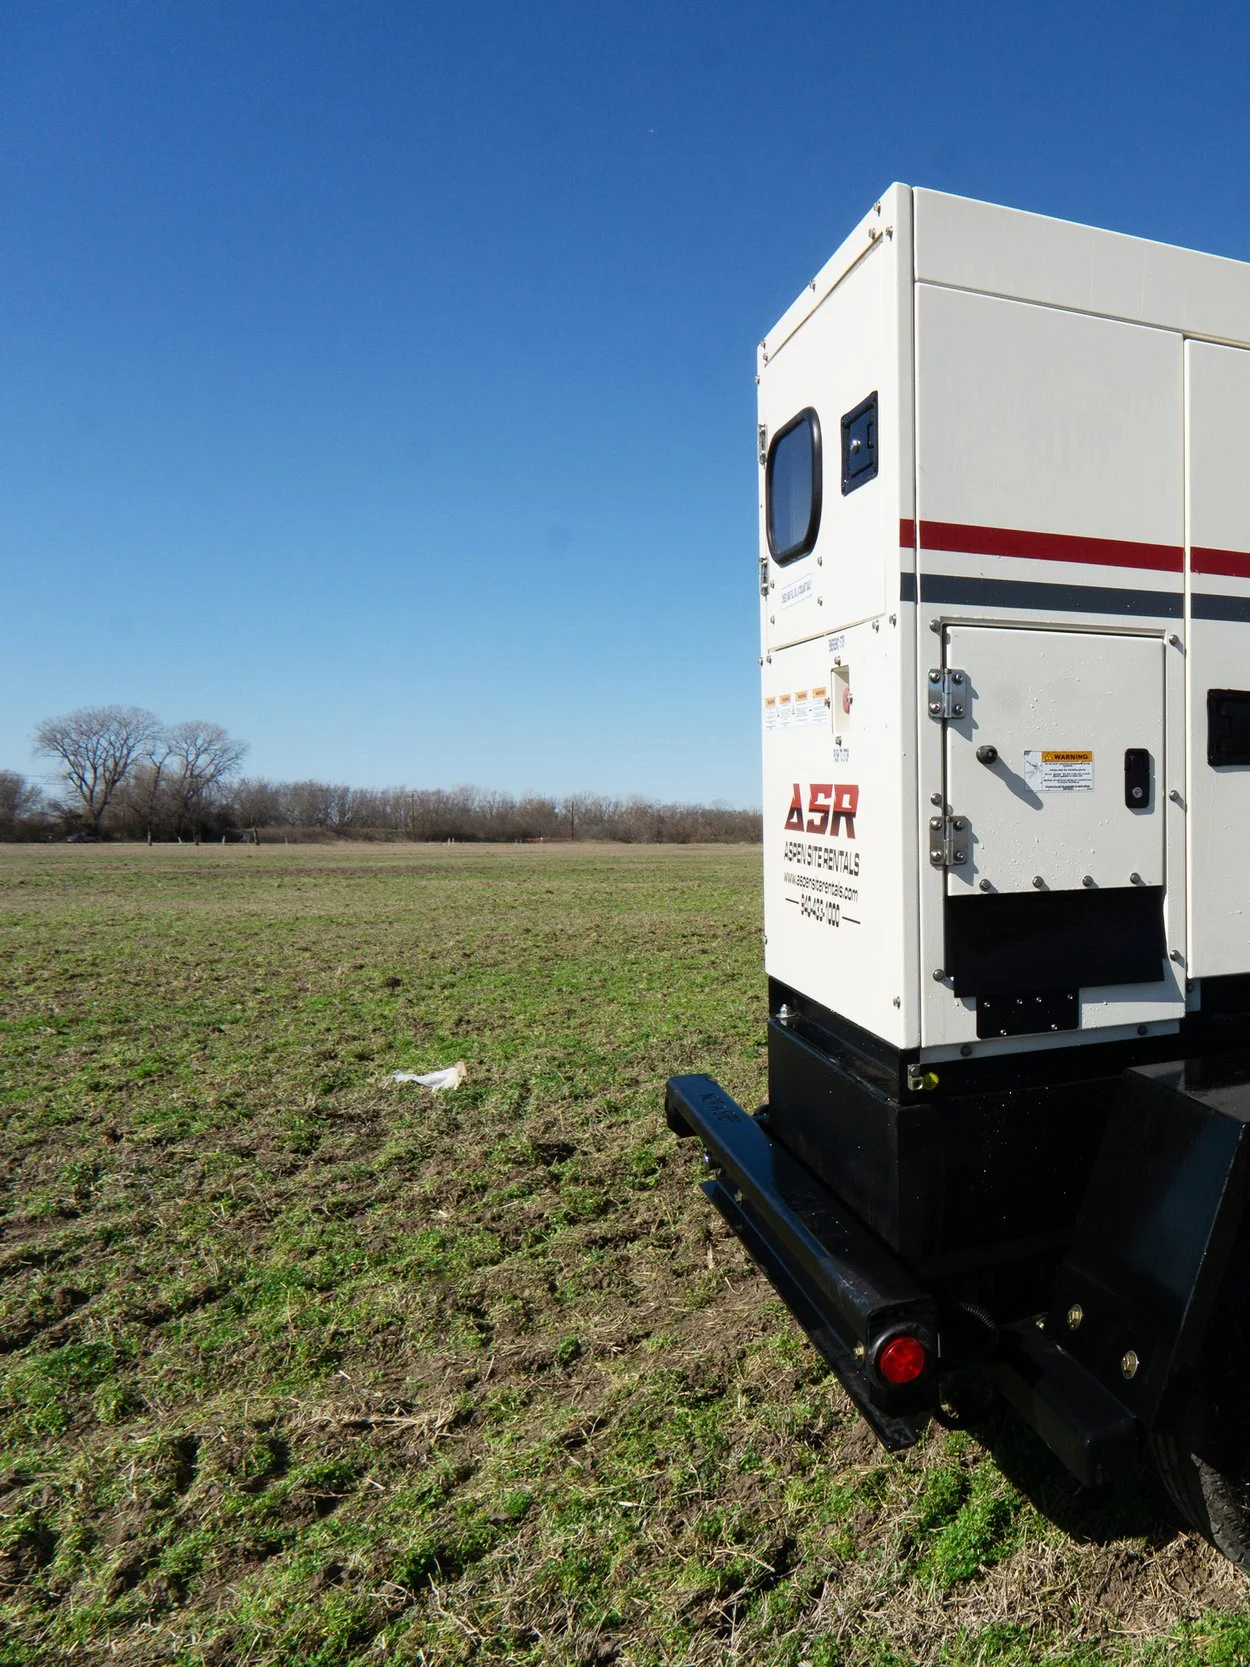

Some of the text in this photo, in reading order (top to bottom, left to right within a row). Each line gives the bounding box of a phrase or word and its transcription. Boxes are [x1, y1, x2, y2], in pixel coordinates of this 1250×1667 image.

[784, 783, 860, 839] ASR
[784, 841, 860, 877] ASPEN SITE RENTALS
